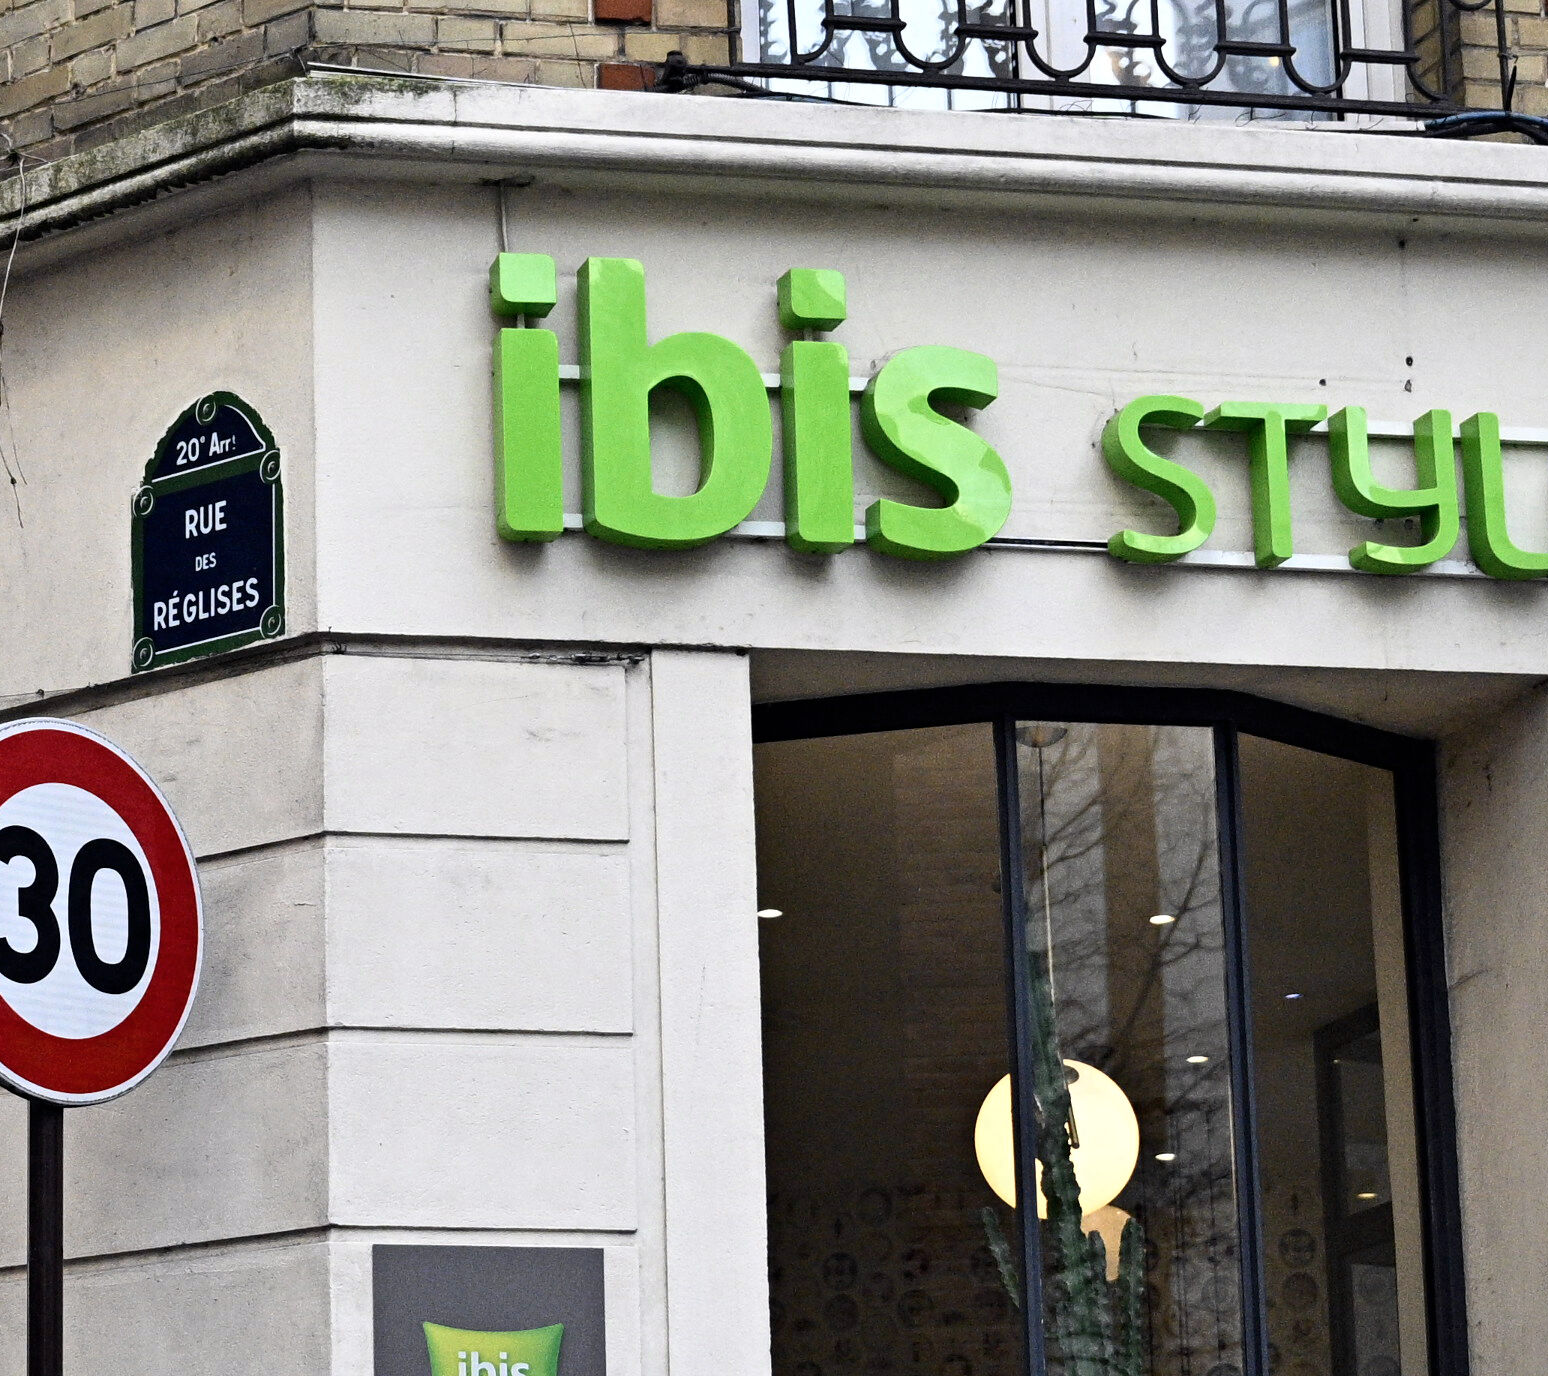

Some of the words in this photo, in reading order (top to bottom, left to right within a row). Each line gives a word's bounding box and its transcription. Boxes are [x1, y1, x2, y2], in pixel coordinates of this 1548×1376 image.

[488, 251, 1012, 561] ibis
[185, 500, 227, 539] RUE
[195, 552, 216, 572] DES
[153, 577, 259, 631] RÉGLISES
